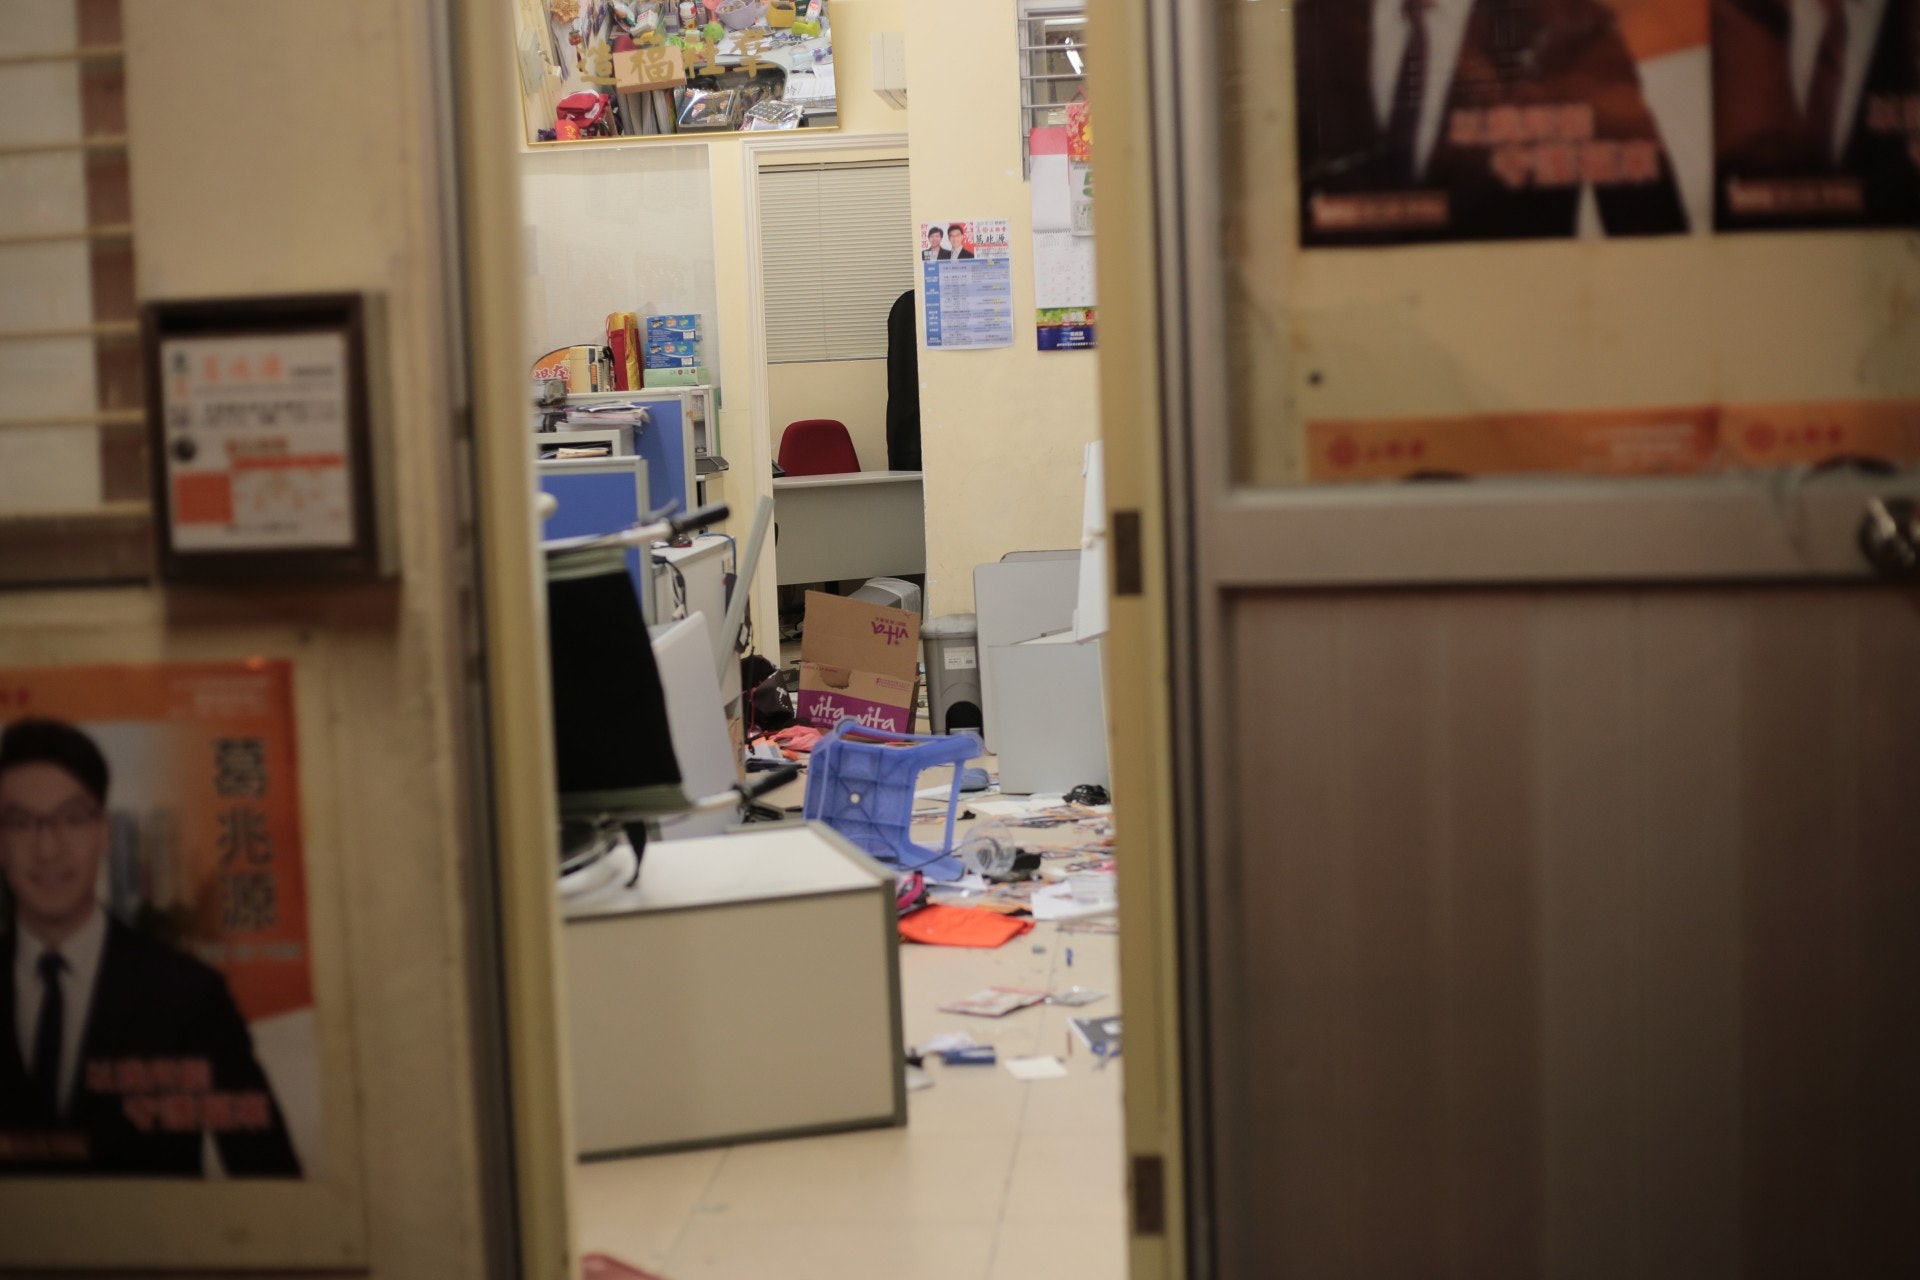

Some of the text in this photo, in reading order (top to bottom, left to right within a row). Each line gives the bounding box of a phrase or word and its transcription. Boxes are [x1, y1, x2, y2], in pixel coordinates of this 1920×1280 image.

[871, 621, 909, 645] vita
[809, 695, 845, 719] vita
[857, 706, 896, 733] vita
